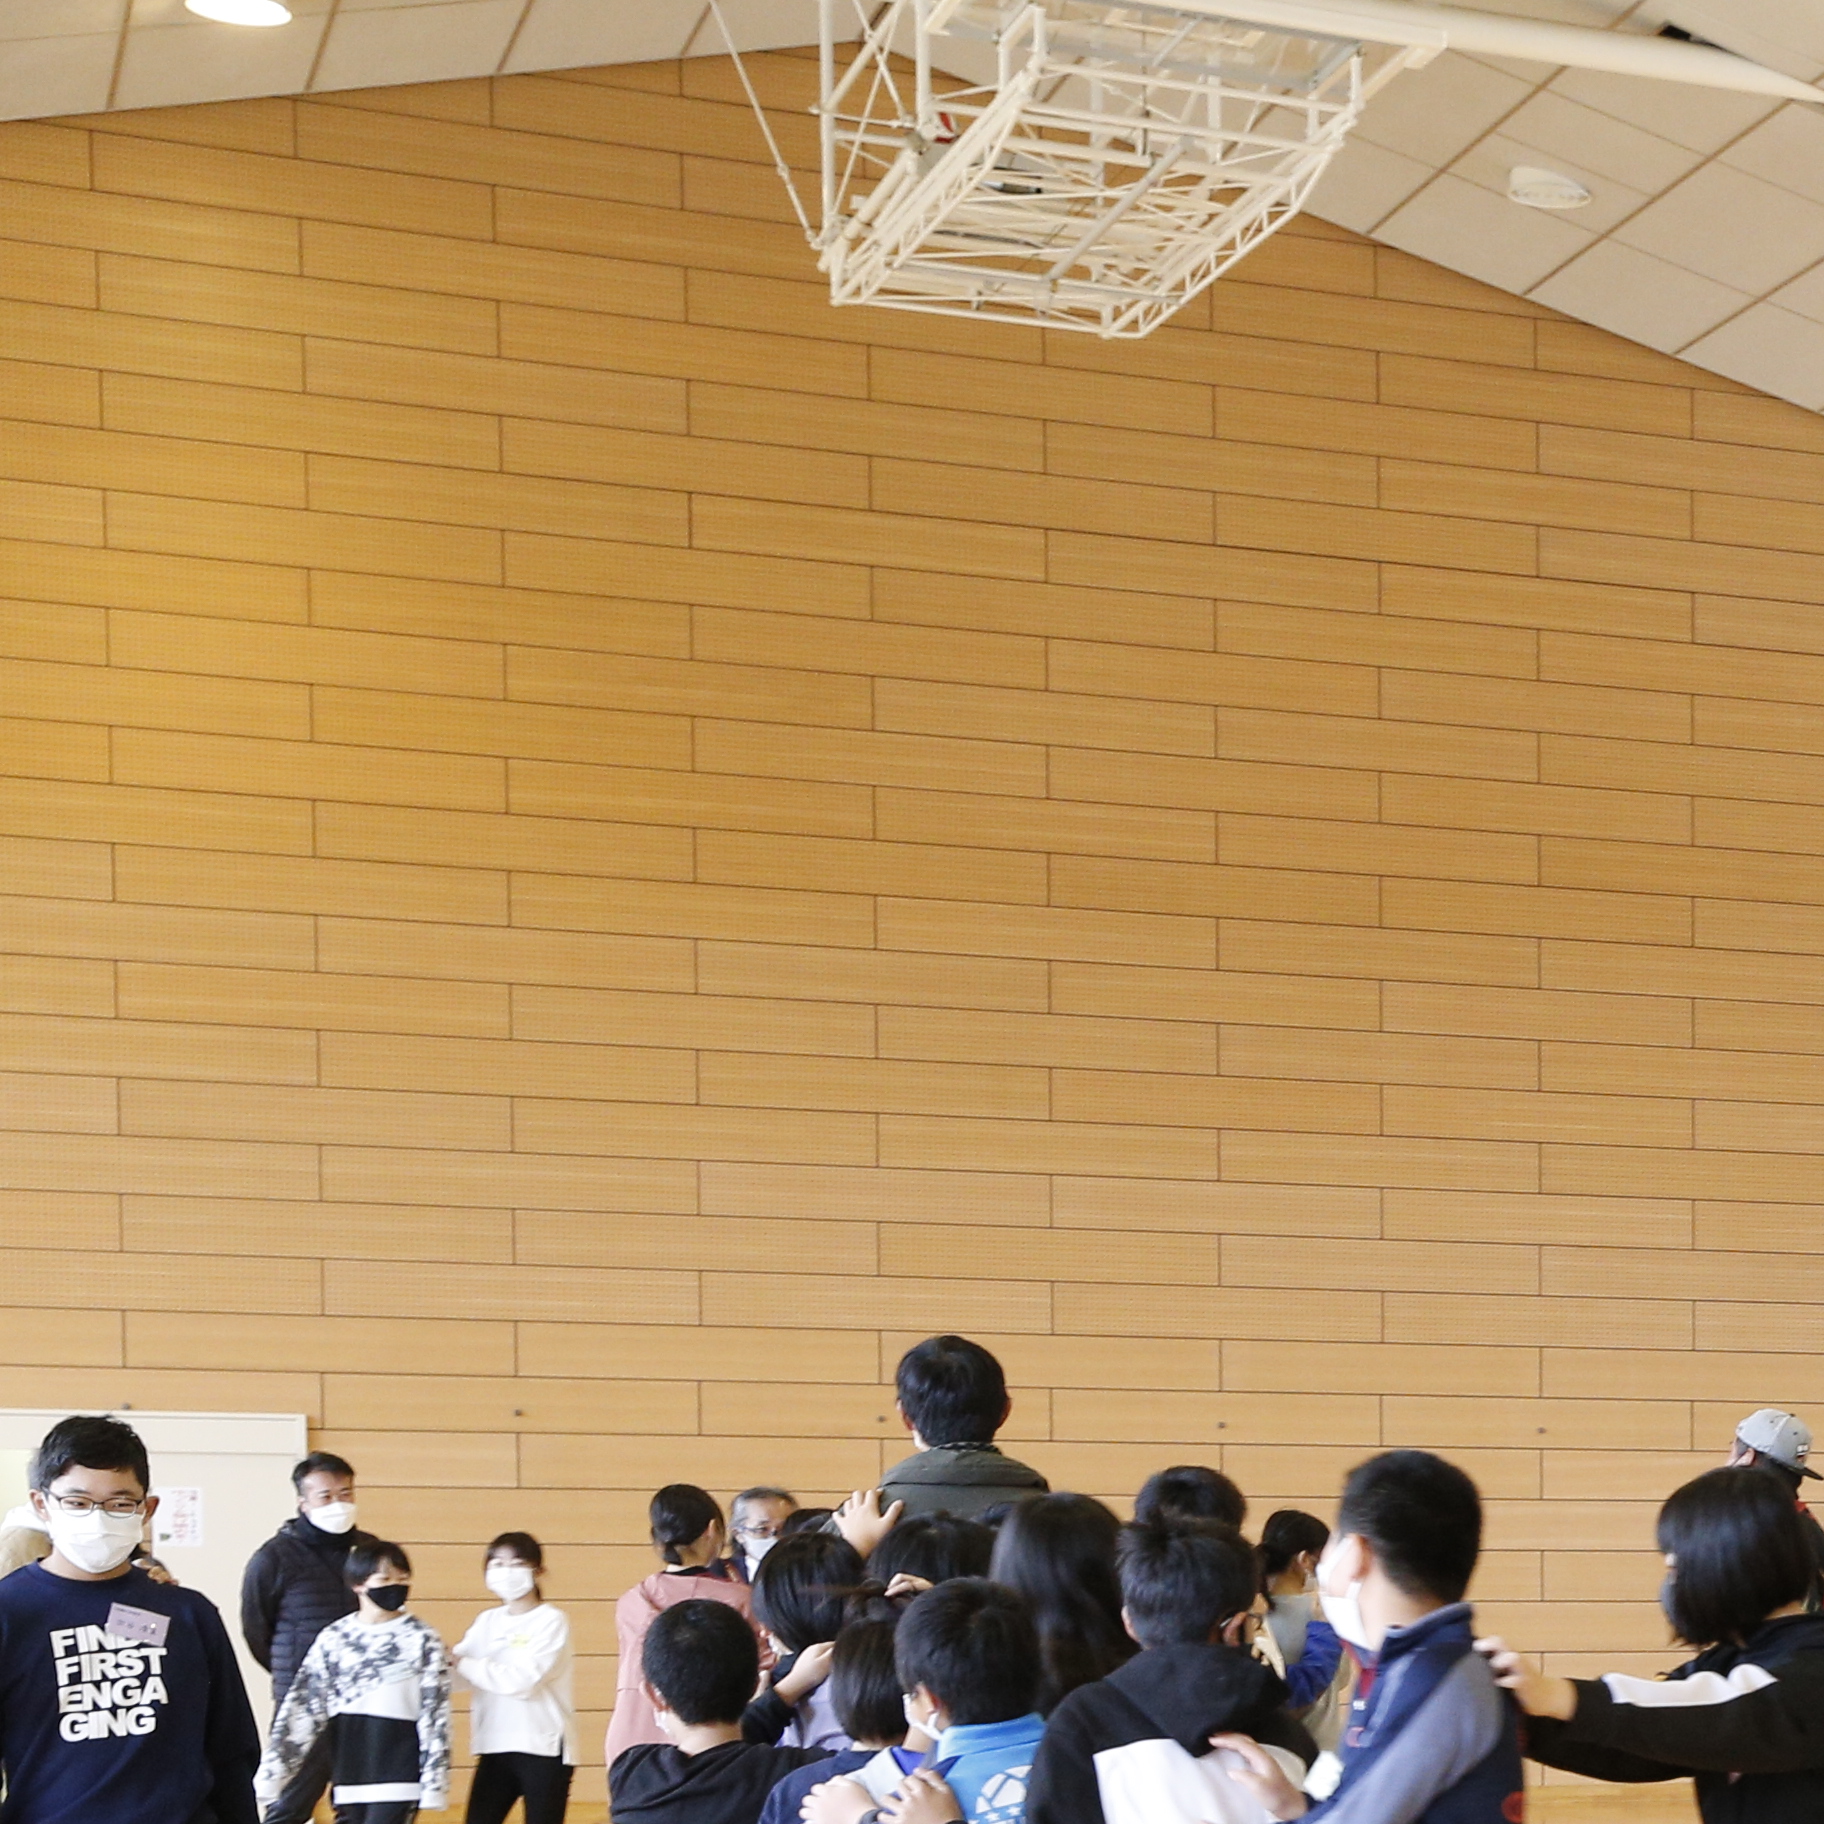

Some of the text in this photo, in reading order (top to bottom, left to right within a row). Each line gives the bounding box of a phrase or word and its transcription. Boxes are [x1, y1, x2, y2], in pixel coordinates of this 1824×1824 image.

[55, 1647, 168, 1687] FIRST
[58, 1676, 169, 1714] ENGA
[59, 1705, 156, 1743] GING
